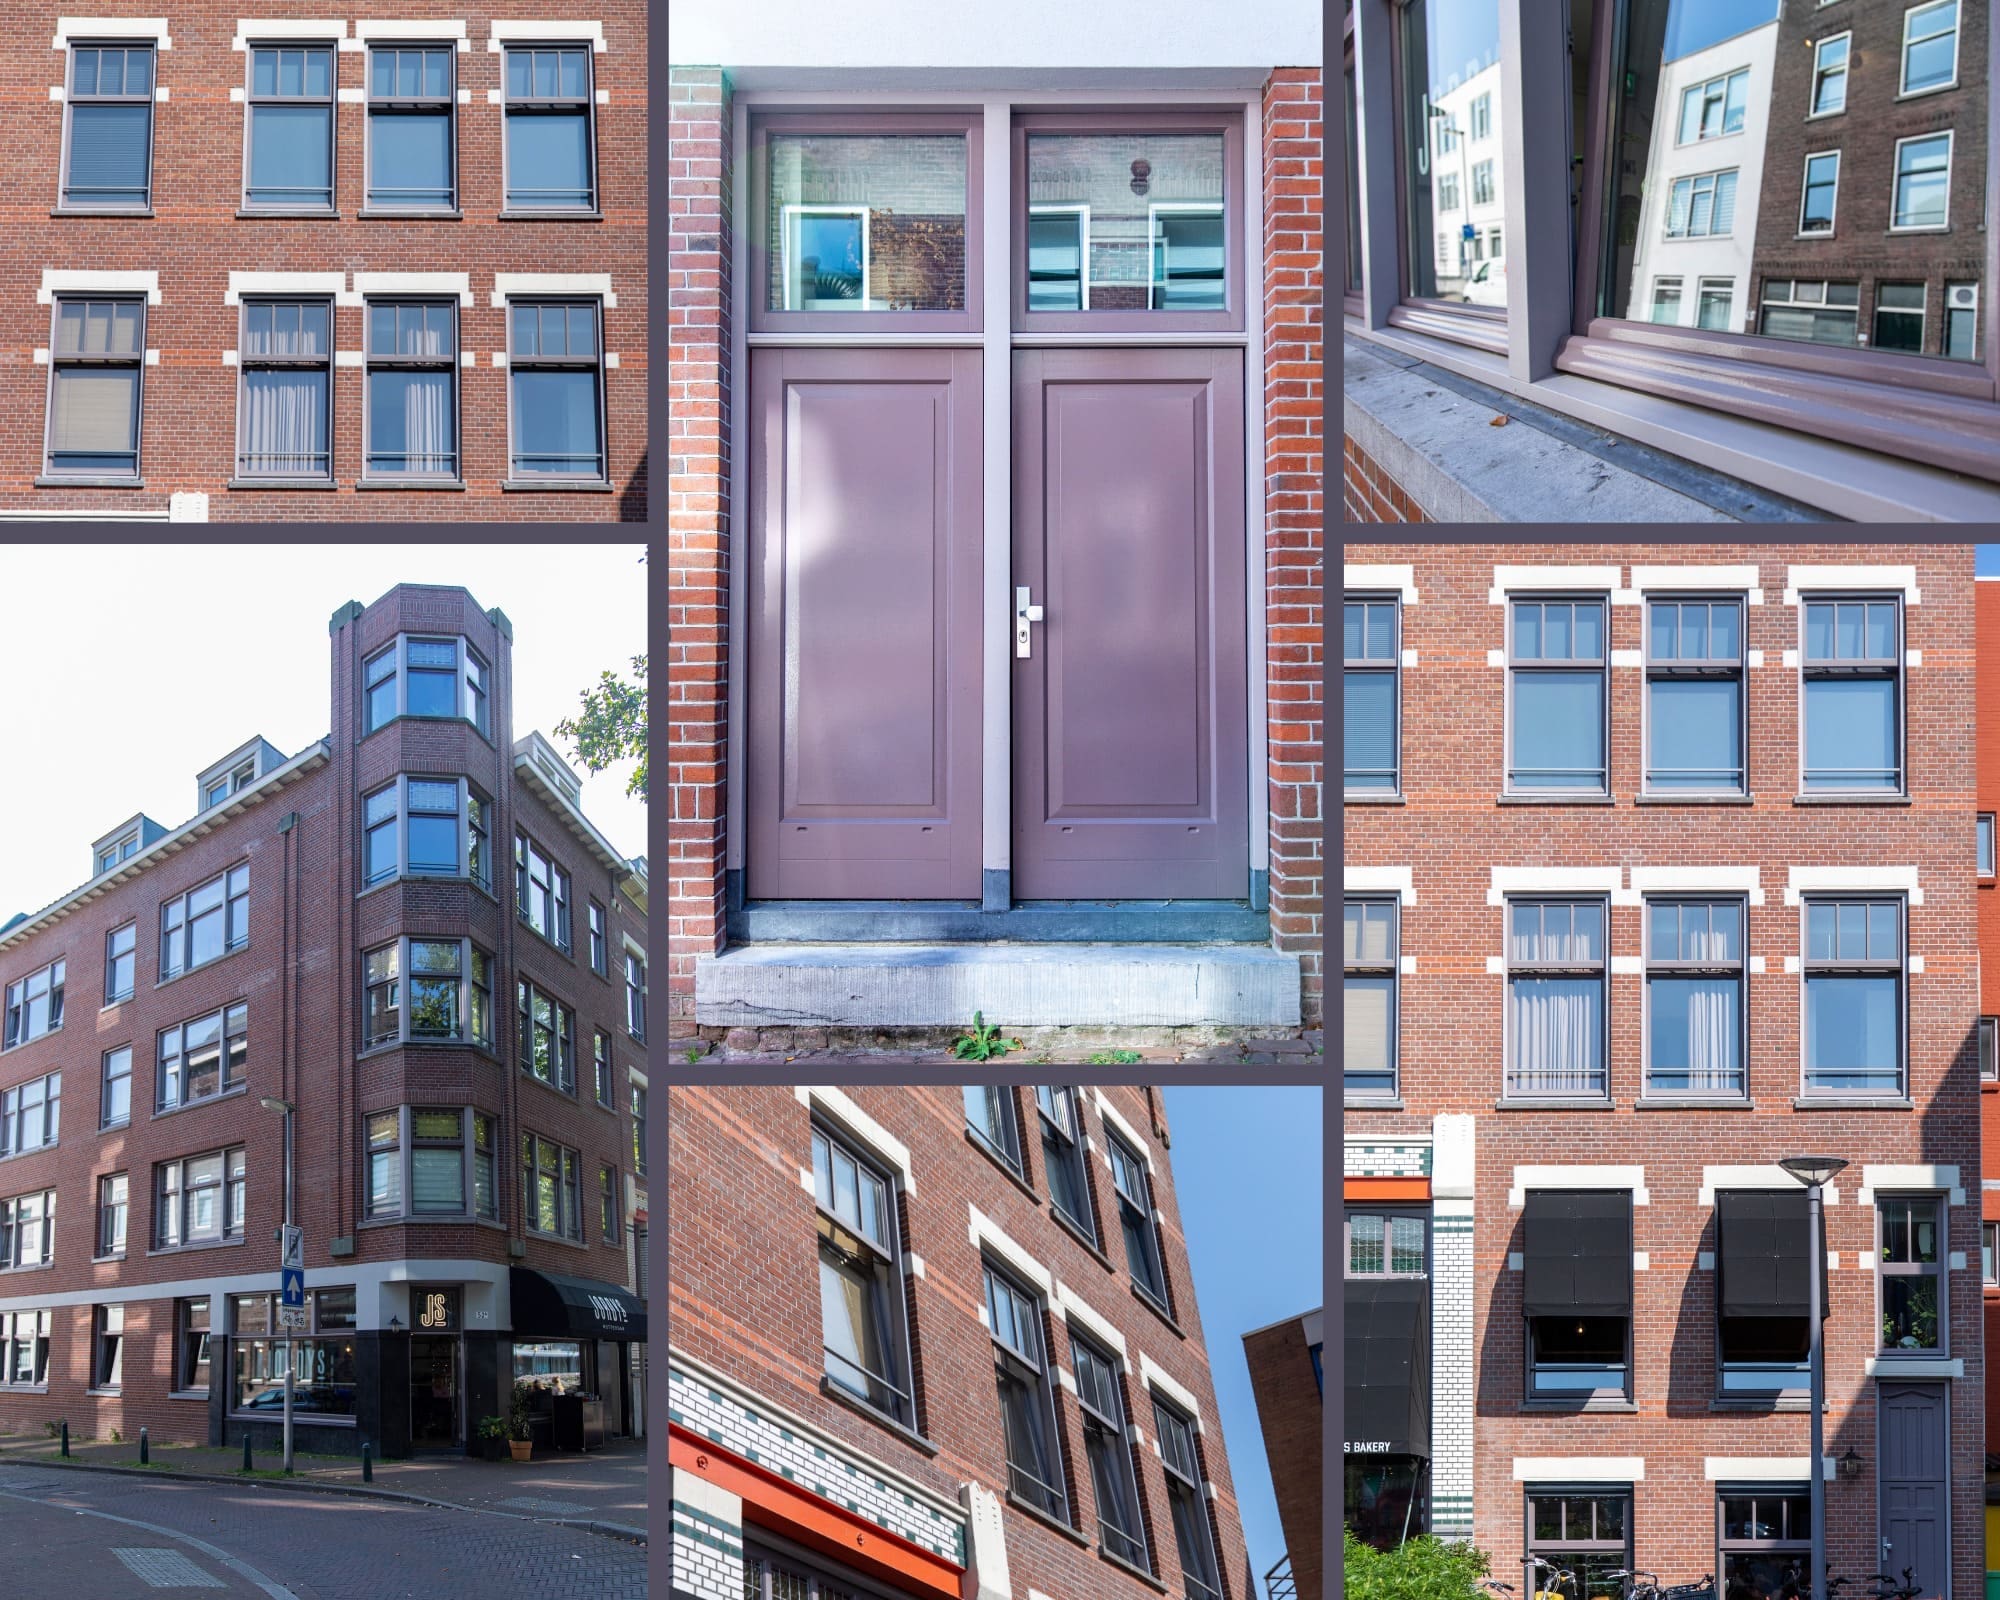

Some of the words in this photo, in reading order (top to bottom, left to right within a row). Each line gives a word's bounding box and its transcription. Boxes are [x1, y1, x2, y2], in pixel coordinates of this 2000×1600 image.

[421, 1294, 446, 1327] JS
[264, 1348, 326, 1379] JODYS
[1354, 1442, 1391, 1452] BAKERY
